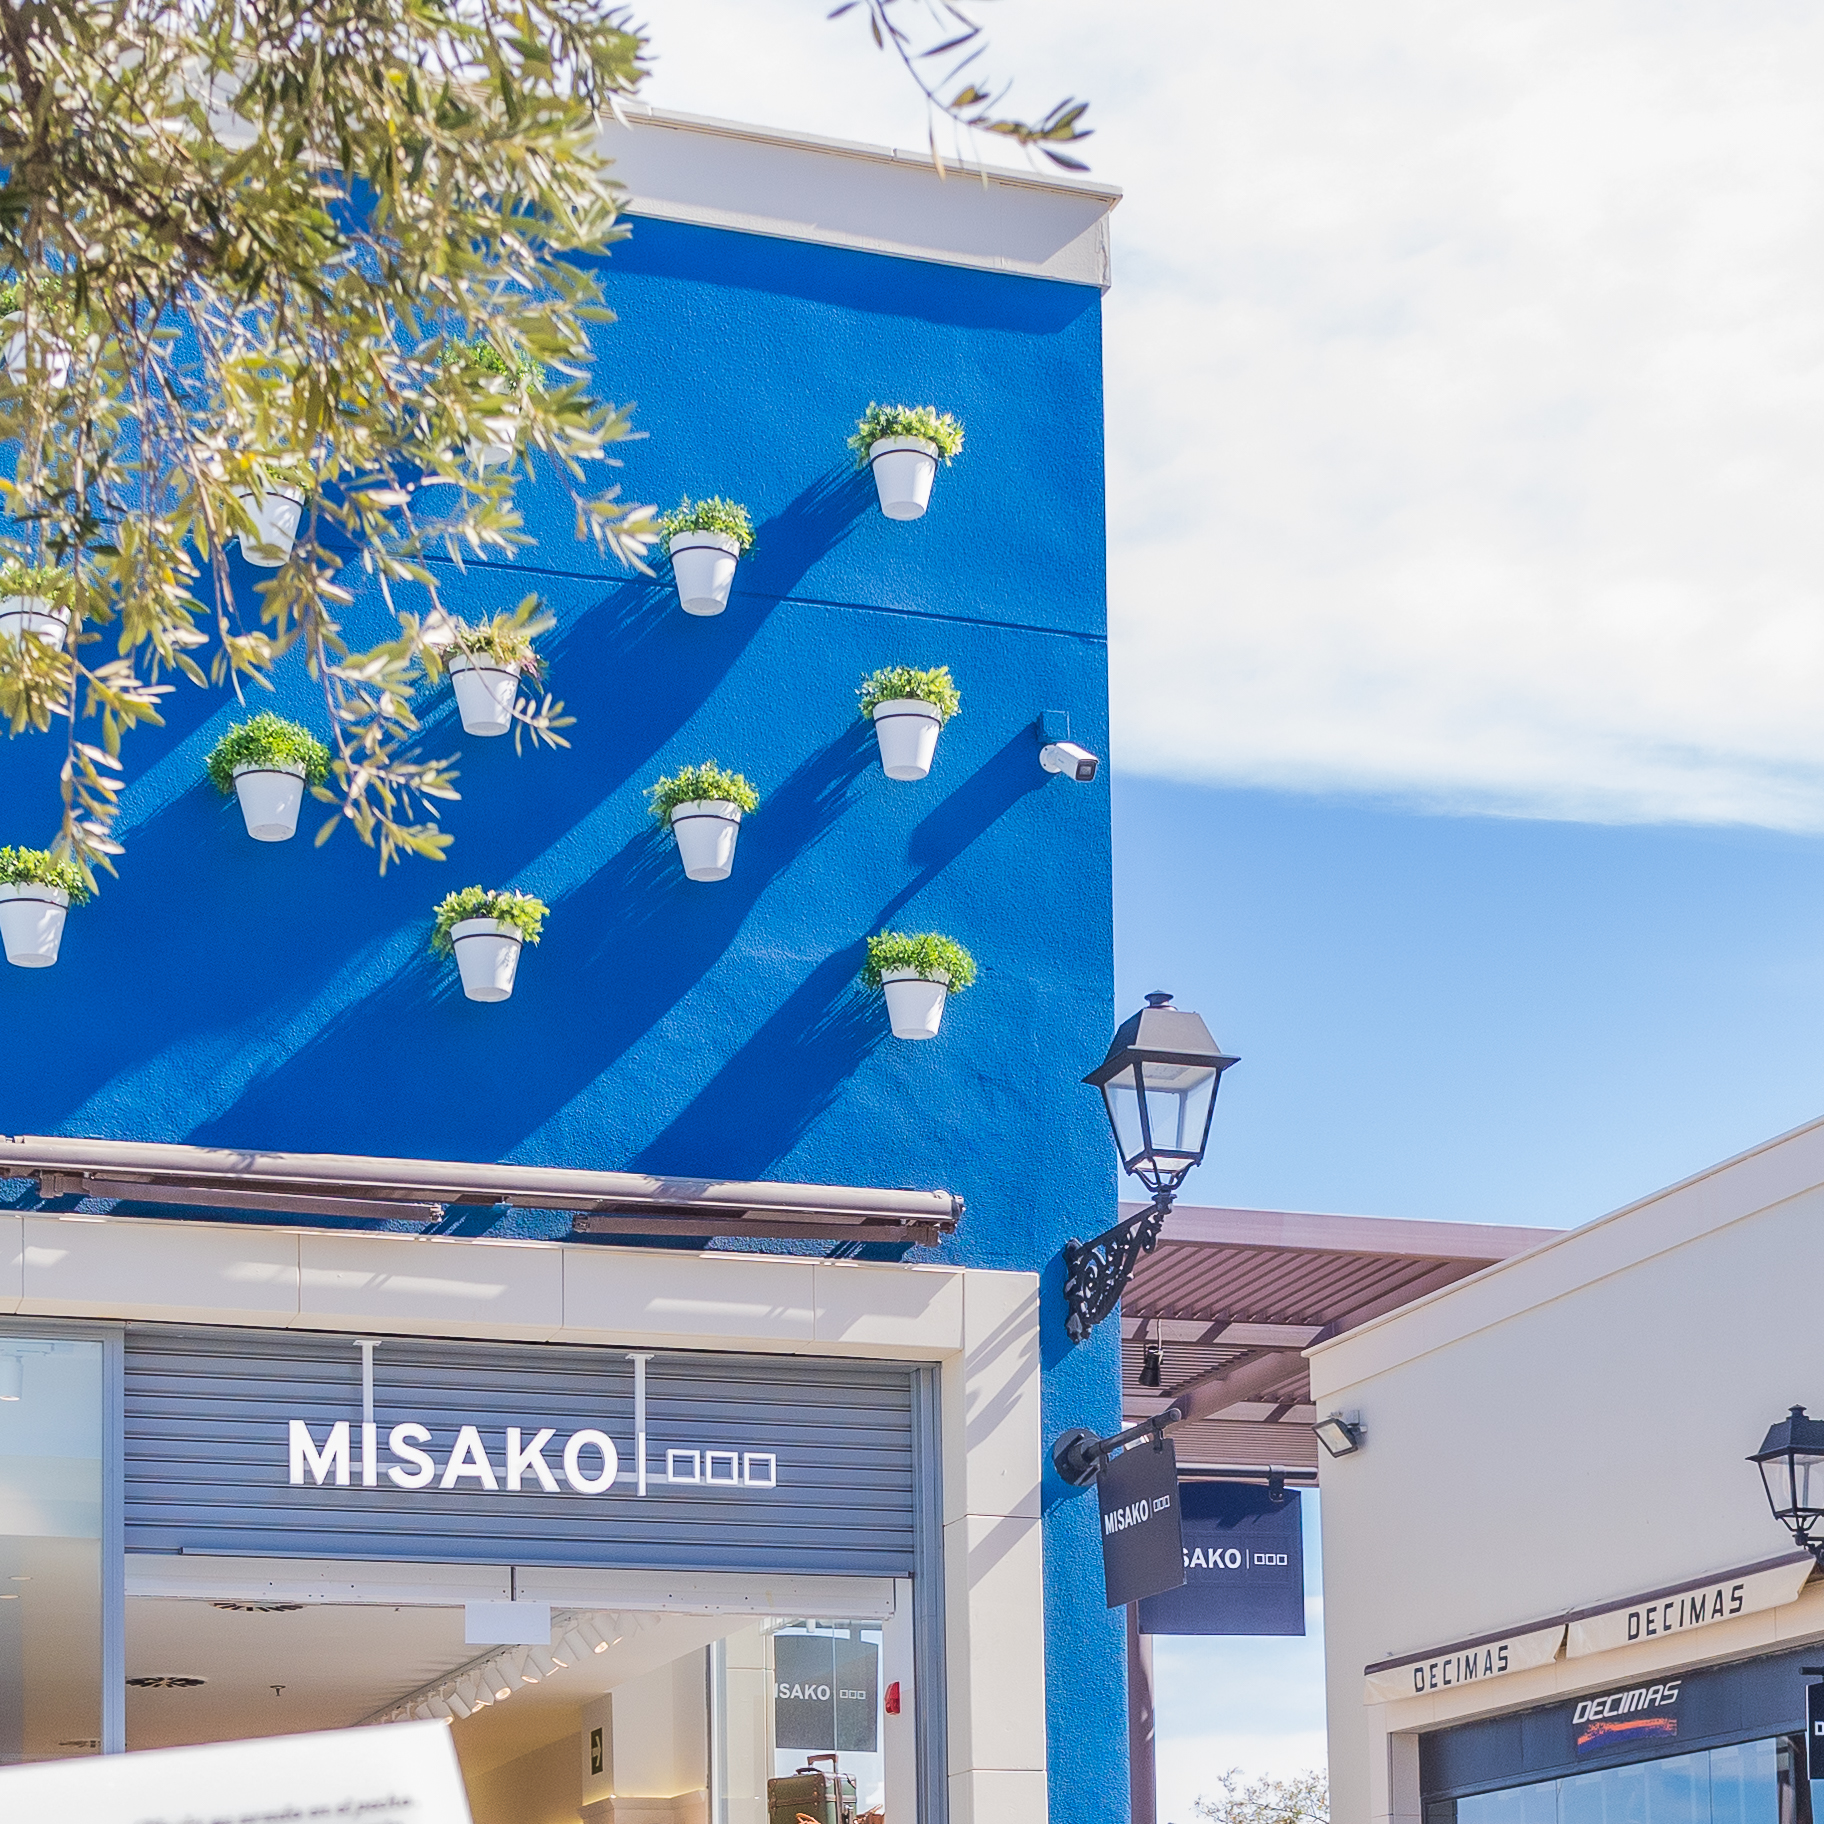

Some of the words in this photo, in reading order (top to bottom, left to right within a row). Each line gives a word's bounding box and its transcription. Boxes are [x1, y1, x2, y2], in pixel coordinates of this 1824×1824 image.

[289, 1419, 619, 1495] MISAKO
[1104, 1499, 1148, 1535] MISAKO
[1183, 1547, 1242, 1569] SAKO
[1627, 1583, 1745, 1641] DECIMAS
[1413, 1644, 1509, 1693] DECIMAS
[774, 1682, 831, 1701] ISAKO
[1572, 1680, 1682, 1724] DECIMAS
